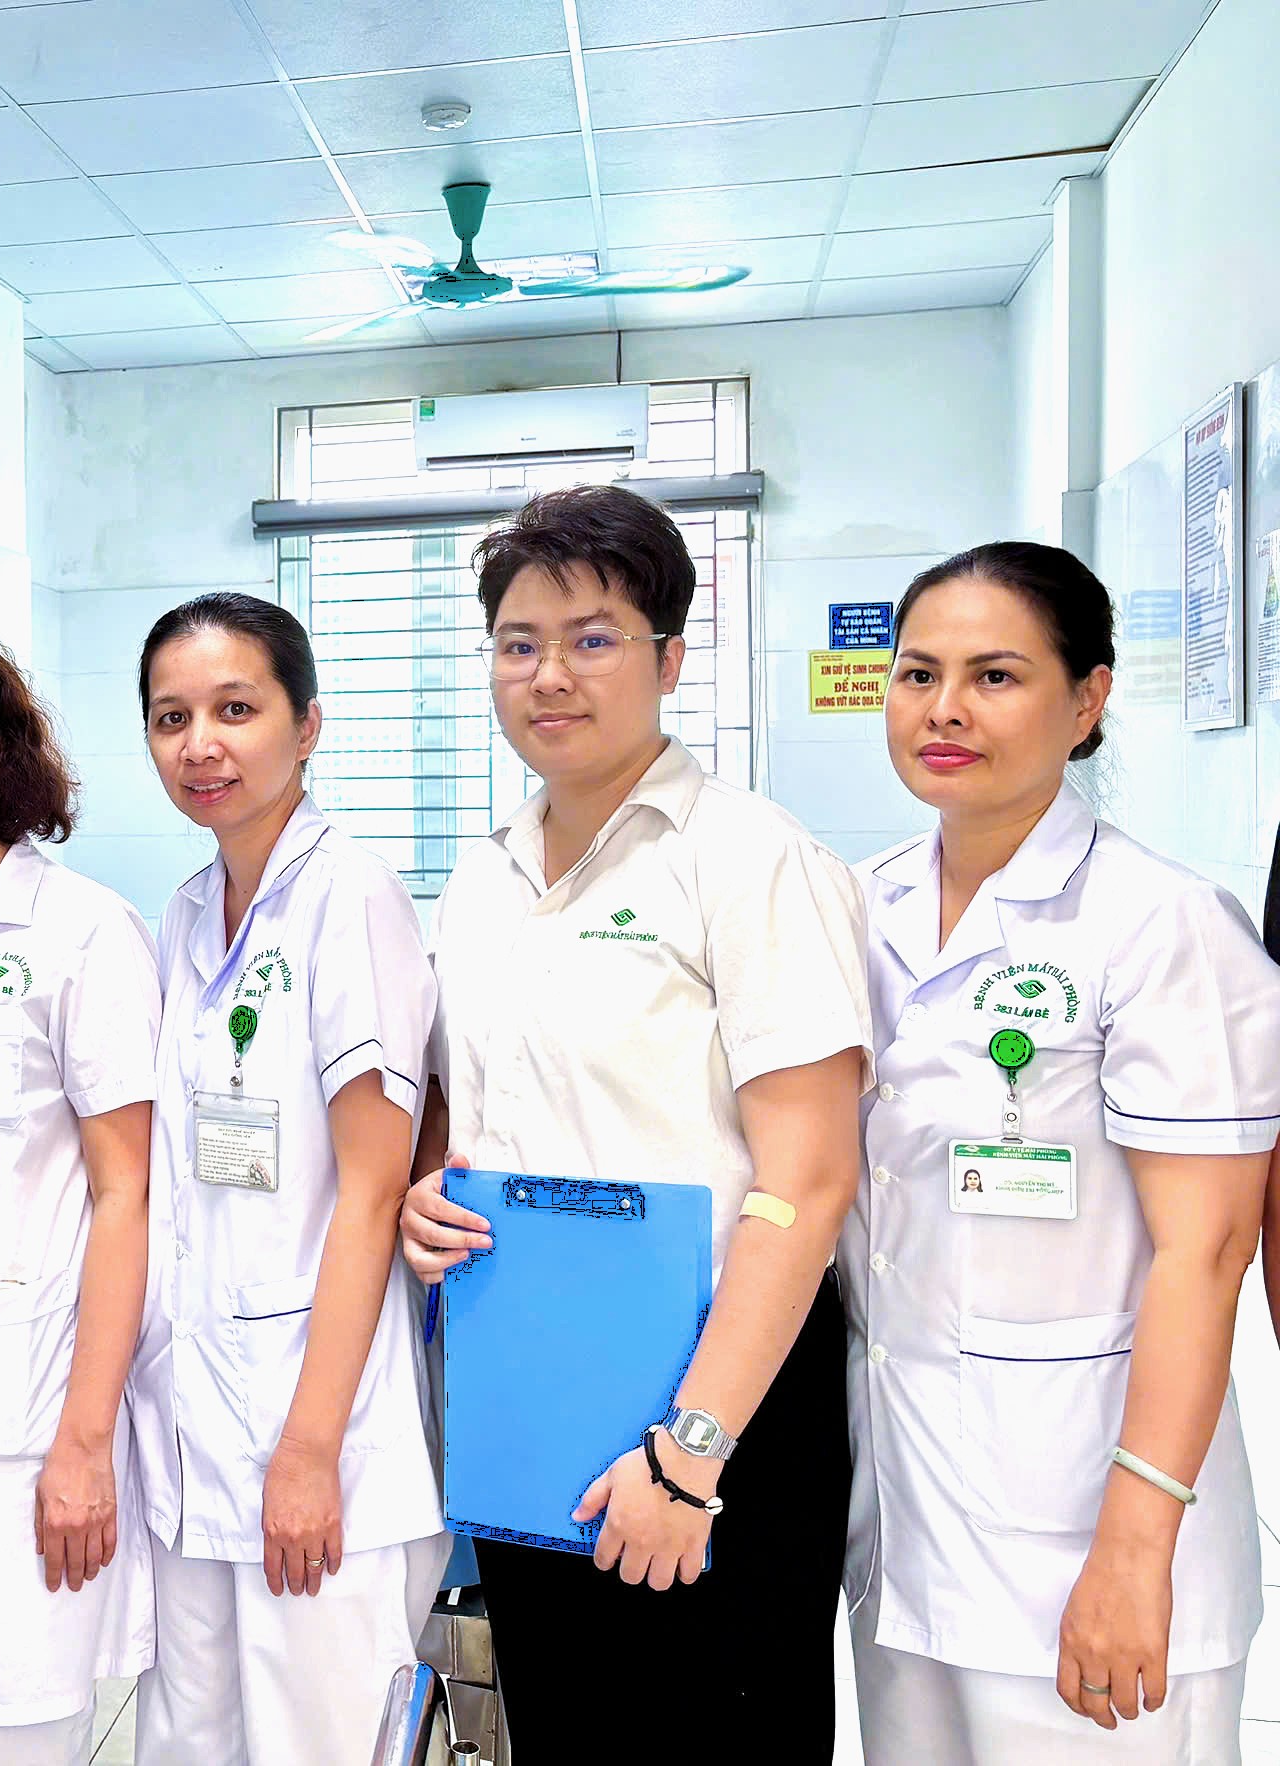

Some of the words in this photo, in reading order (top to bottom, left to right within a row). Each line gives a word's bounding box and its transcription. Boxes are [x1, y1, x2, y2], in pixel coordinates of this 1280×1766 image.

[844, 663, 851, 675] VỆ
[853, 664, 867, 674] SINH
[852, 681, 879, 694] NGHỊ
[276, 958, 292, 992] PHÒNG
[974, 977, 994, 1010] BỆNH
[992, 964, 1024, 980] VIỆN
[1028, 962, 1053, 974] MẮT
[1062, 983, 1080, 1023] PHÒNG
